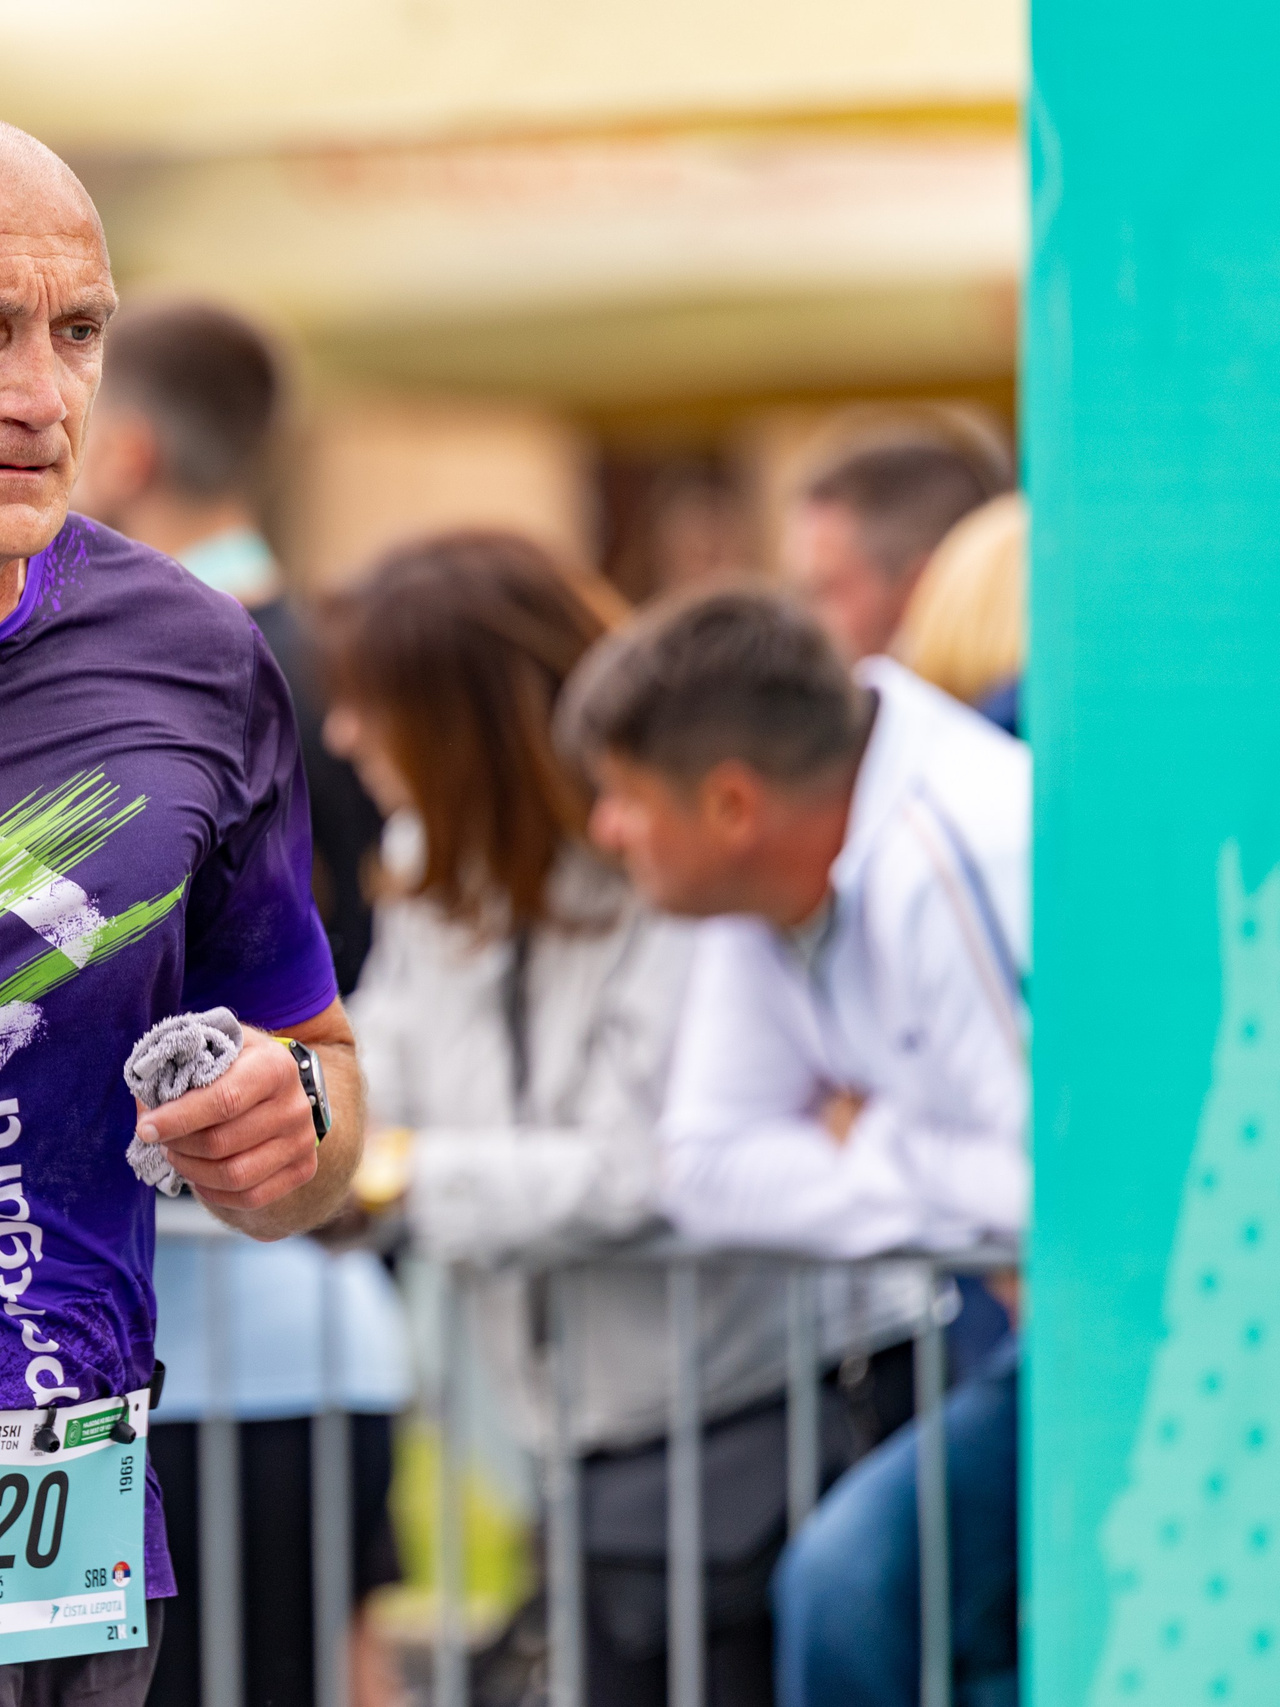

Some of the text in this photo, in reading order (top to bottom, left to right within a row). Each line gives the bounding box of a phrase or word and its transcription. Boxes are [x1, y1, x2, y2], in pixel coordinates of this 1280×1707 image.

[119, 1455, 133, 1495] 1965
[85, 1568, 107, 1588] SRB
[90, 1600, 122, 1614] LEPOTA
[107, 1623, 127, 1640] 21K
